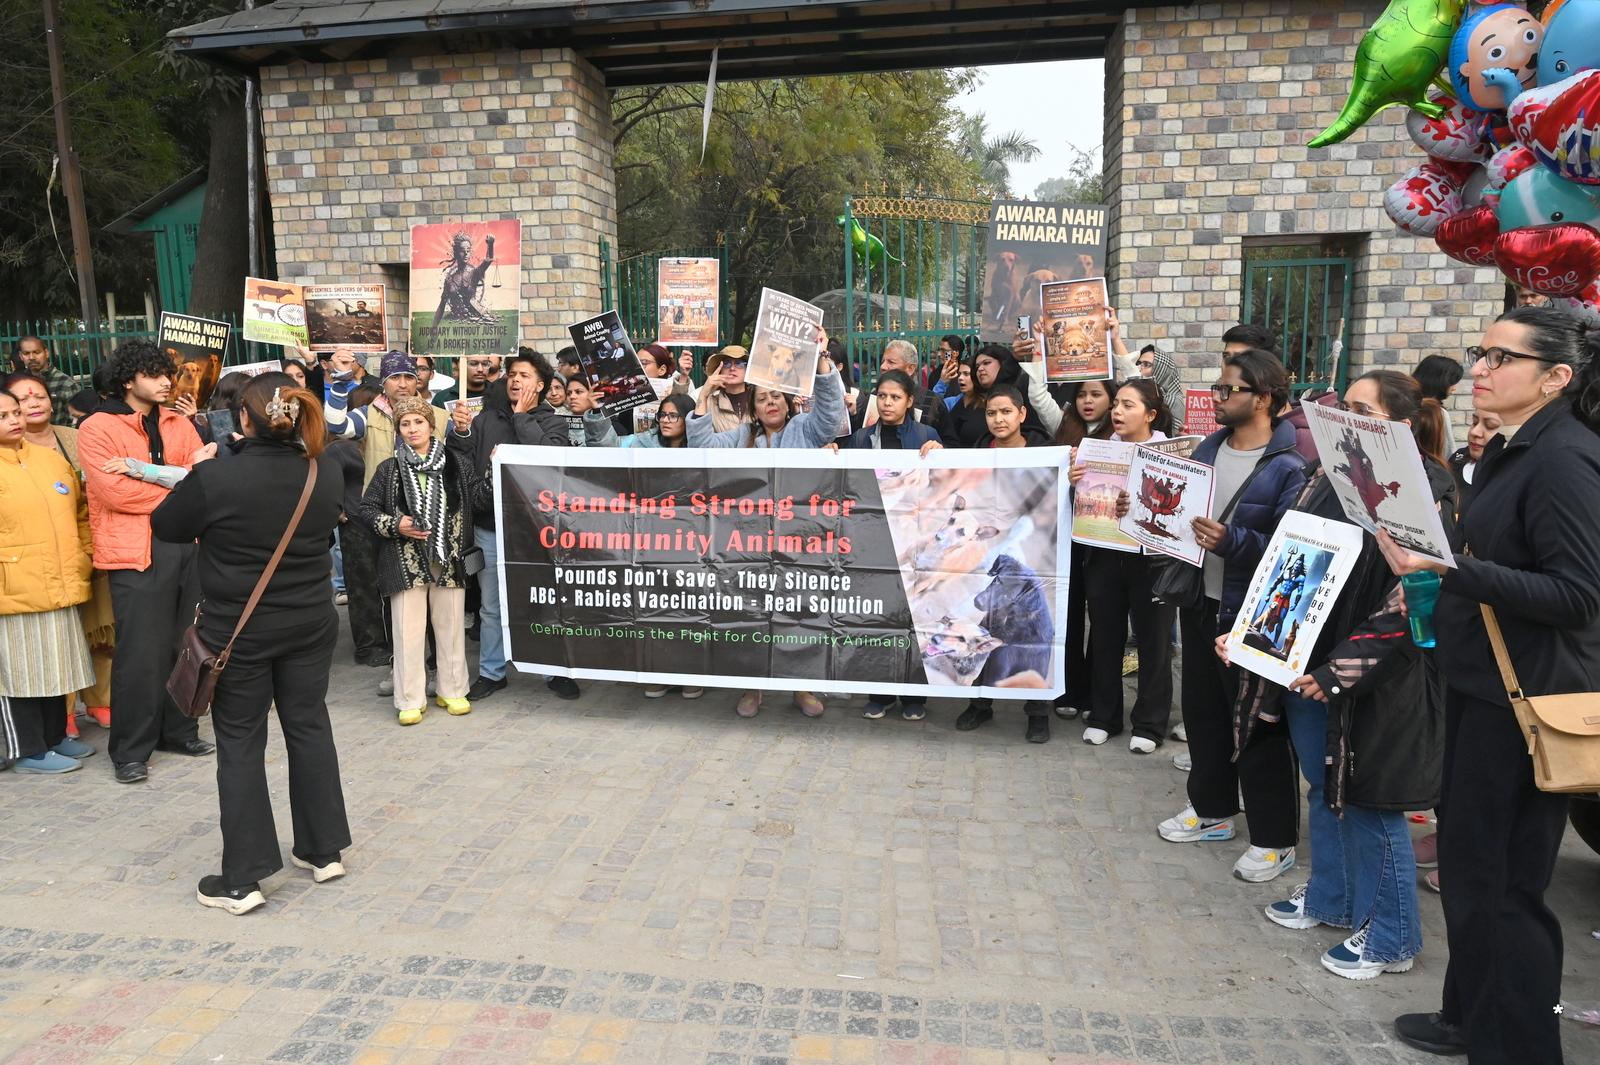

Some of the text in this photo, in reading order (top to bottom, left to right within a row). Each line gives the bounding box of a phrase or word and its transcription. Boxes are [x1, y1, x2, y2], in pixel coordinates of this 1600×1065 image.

[995, 205, 1105, 227] AWARA NAHI
[996, 223, 1101, 246] HAMARA HAI
[1514, 266, 1579, 293] I Love
[163, 317, 227, 338] AWARA NAHI
[419, 326, 508, 336] JUDICIARY WITHOUT JUSTICE
[584, 320, 604, 334] AWBI
[769, 311, 813, 339] WHY?
[163, 328, 224, 350] HAMARA HAI
[427, 339, 501, 349] IS A BROKEN SYSTEM
[596, 335, 606, 343] India
[1347, 416, 1353, 427] &
[1160, 443, 1177, 452] BITES
[1168, 471, 1188, 481] ANIMALS
[537, 489, 857, 521] Standing Strong for
[539, 525, 853, 557] Community Animals
[1404, 524, 1426, 536] DISSENT
[554, 567, 617, 586] Pounds
[624, 568, 669, 587] Don't
[675, 569, 717, 588] Save
[737, 571, 778, 592] They
[784, 571, 851, 592] Silence
[530, 587, 884, 615] ABC + Rabies Vaccination = Real Solution
[530, 622, 911, 649] (Dehradun Joins the Fight for Community Animals)
